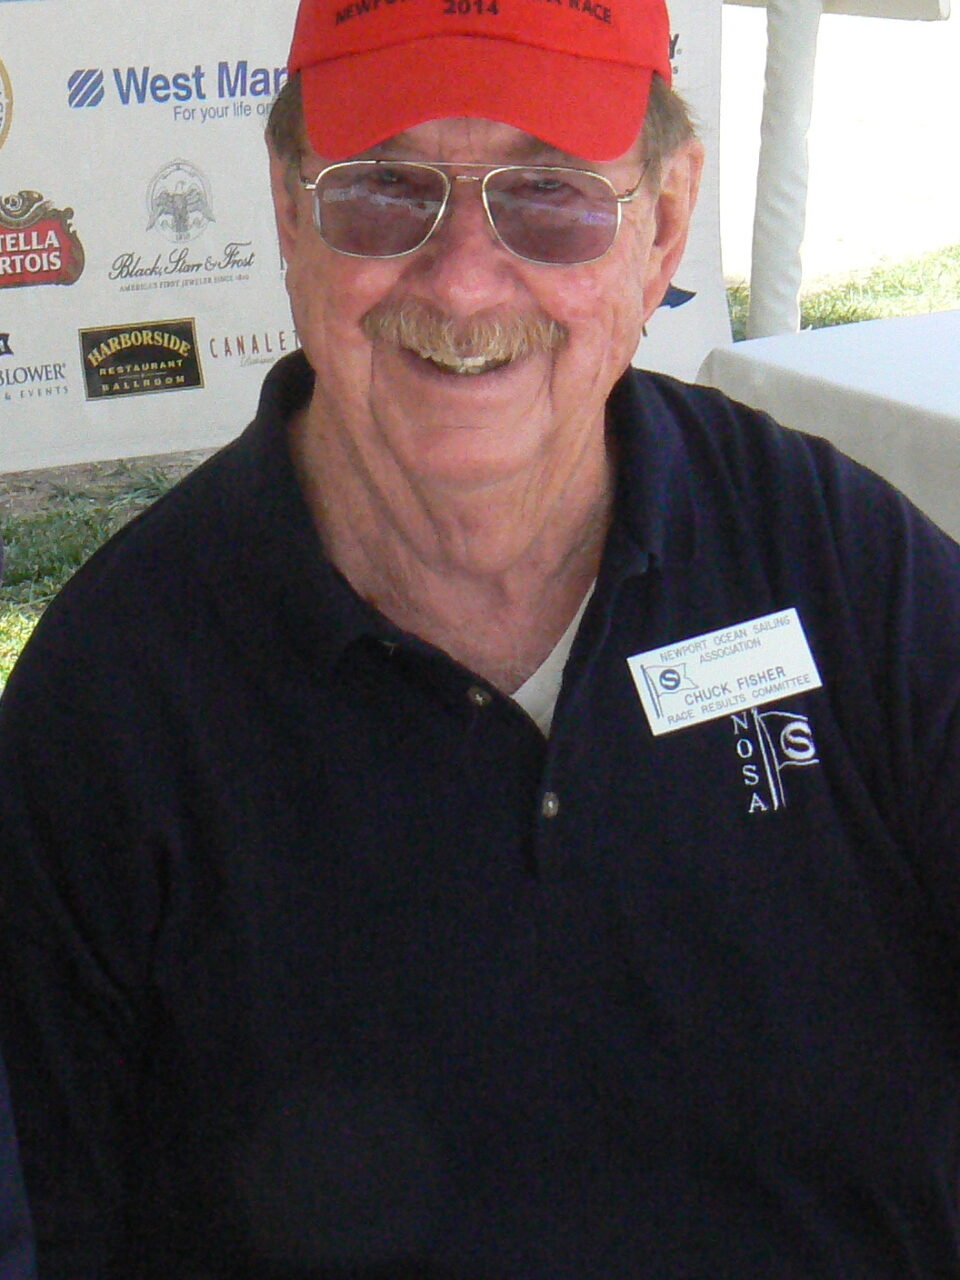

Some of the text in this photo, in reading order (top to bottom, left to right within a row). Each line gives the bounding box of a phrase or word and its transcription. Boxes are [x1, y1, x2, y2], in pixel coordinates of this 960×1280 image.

[112, 60, 289, 106] West Mar
[173, 105, 196, 122] For
[200, 105, 229, 124] your
[233, 101, 252, 118] life
[108, 241, 255, 281] Black, Starr & Frost
[159, 278, 180, 289] FIRST
[87, 329, 191, 367] HARBORSIDE
[209, 330, 301, 358] CANALET
[99, 358, 184, 377] RESTAURANT
[4, 391, 12, 401] &
[20, 386, 69, 400] EVENTS
[101, 375, 186, 393] BALLROOM
[660, 615, 791, 663] NEWPORT OCEAN SAILING
[698, 637, 762, 664] ASSOCIATION
[667, 673, 811, 725] RACE RESULTS COMMITTEE
[684, 665, 787, 706] CHUCK FISHER
